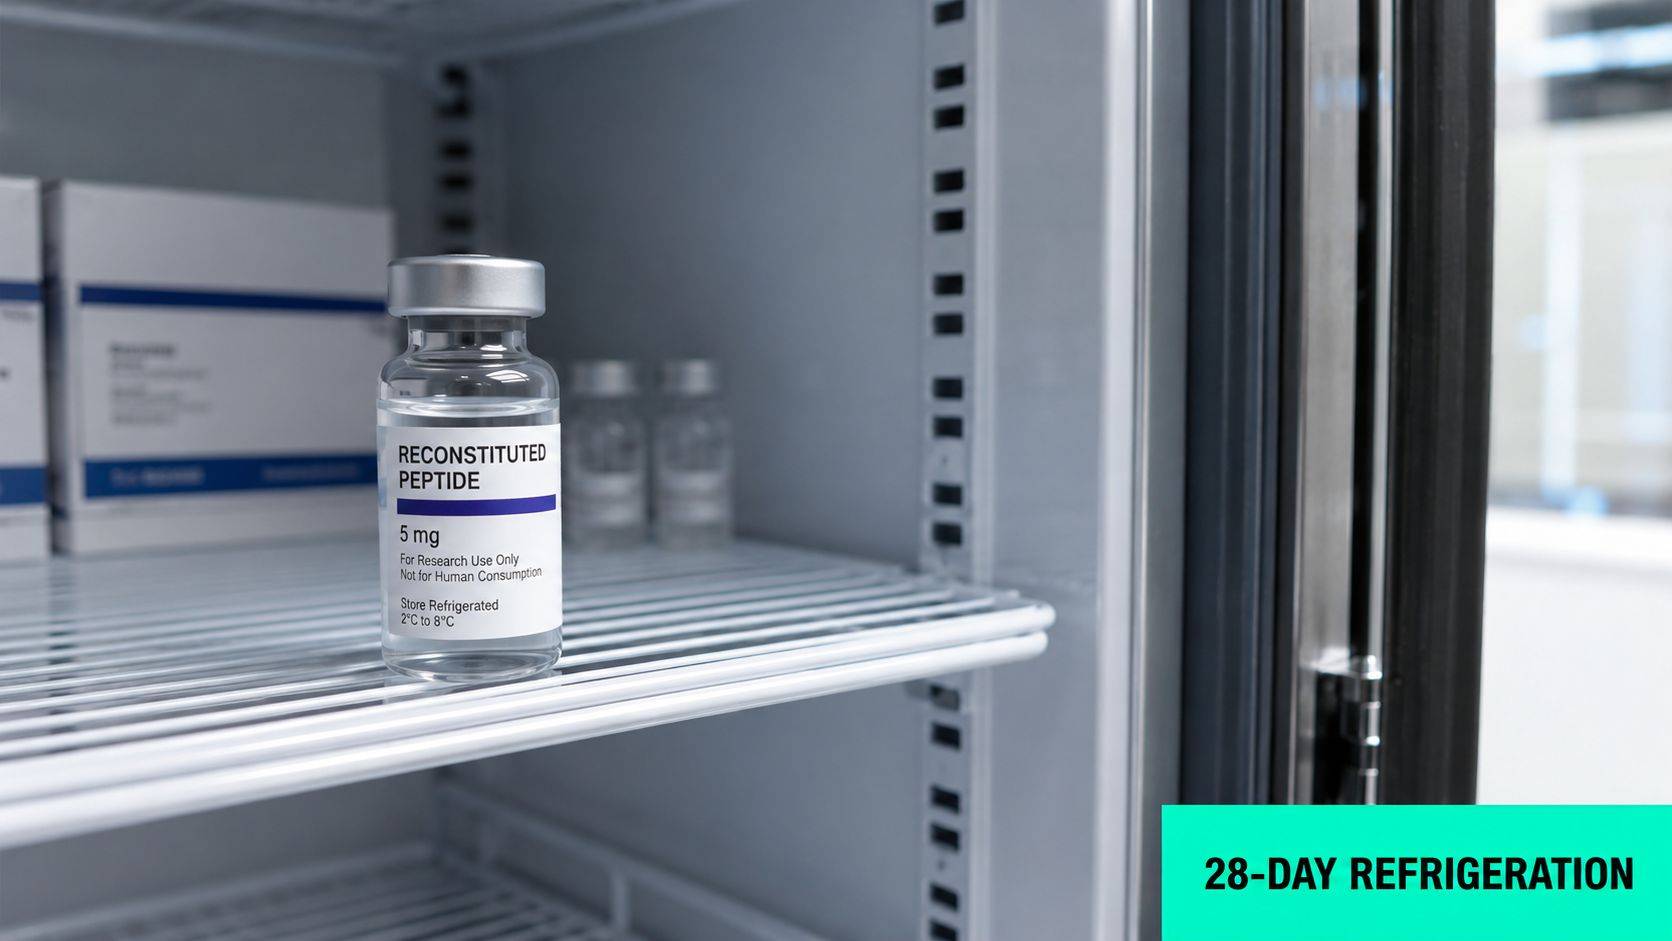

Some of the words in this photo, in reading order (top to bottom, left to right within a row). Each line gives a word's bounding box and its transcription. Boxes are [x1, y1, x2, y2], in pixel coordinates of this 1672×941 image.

[399, 443, 546, 464] RECONSTITUTED
[399, 471, 480, 490] PEPTIDE
[400, 525, 408, 543] 5
[413, 529, 440, 548] mg
[400, 553, 414, 566] For
[418, 554, 468, 567] Research
[471, 555, 493, 567] Use
[496, 553, 520, 567] Only
[400, 569, 416, 581] Not
[418, 569, 432, 582] for
[435, 571, 474, 582] Human
[478, 567, 542, 582] Consumption
[401, 598, 426, 610] Store
[429, 599, 499, 615] Refrigerated
[401, 613, 418, 626] 2°C
[421, 614, 431, 627] to
[434, 615, 454, 628] 8°C
